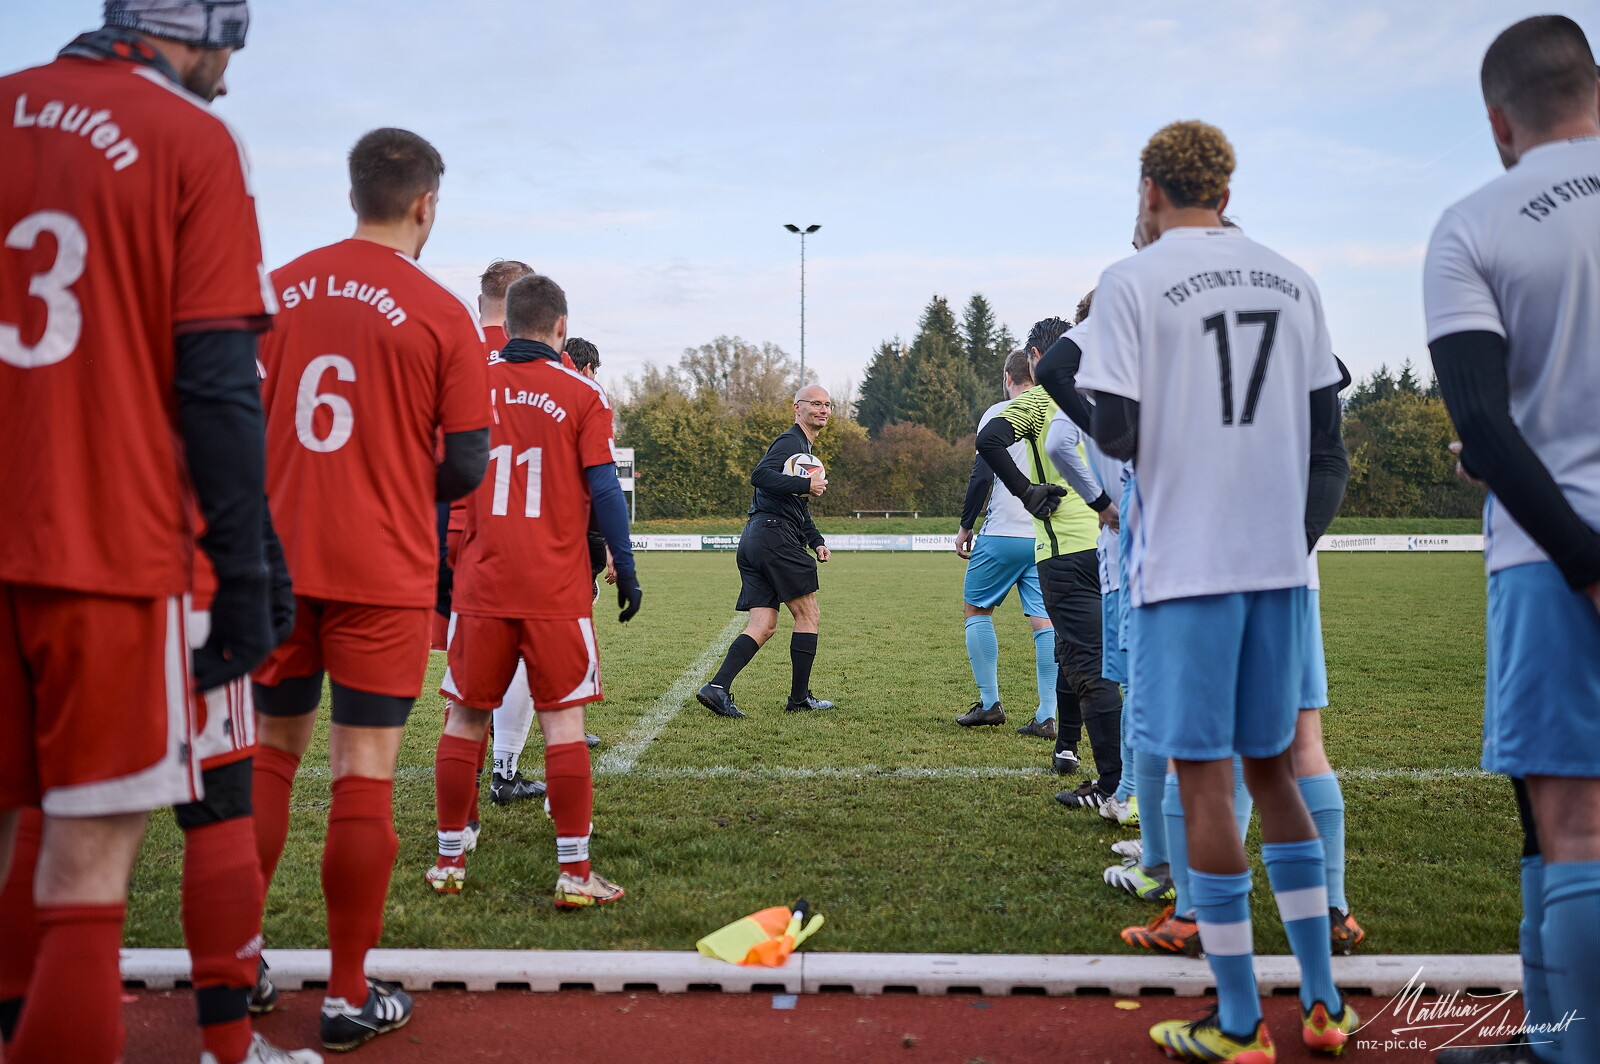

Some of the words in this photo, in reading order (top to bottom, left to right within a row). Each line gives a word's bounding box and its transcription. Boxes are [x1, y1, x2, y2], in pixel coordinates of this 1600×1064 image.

[13, 93, 140, 172] Laufen
[1519, 189, 1560, 223] TSV
[0, 210, 88, 369] 3
[281, 276, 317, 310] SV
[327, 274, 408, 328] Laufen
[1163, 281, 1191, 307] TSV
[1250, 269, 1302, 303] GEORGEN
[1201, 308, 1281, 427] 17
[295, 353, 358, 453] 6
[504, 387, 568, 423] Laufen
[489, 444, 543, 518] 11
[914, 535, 942, 544] Heizöl
